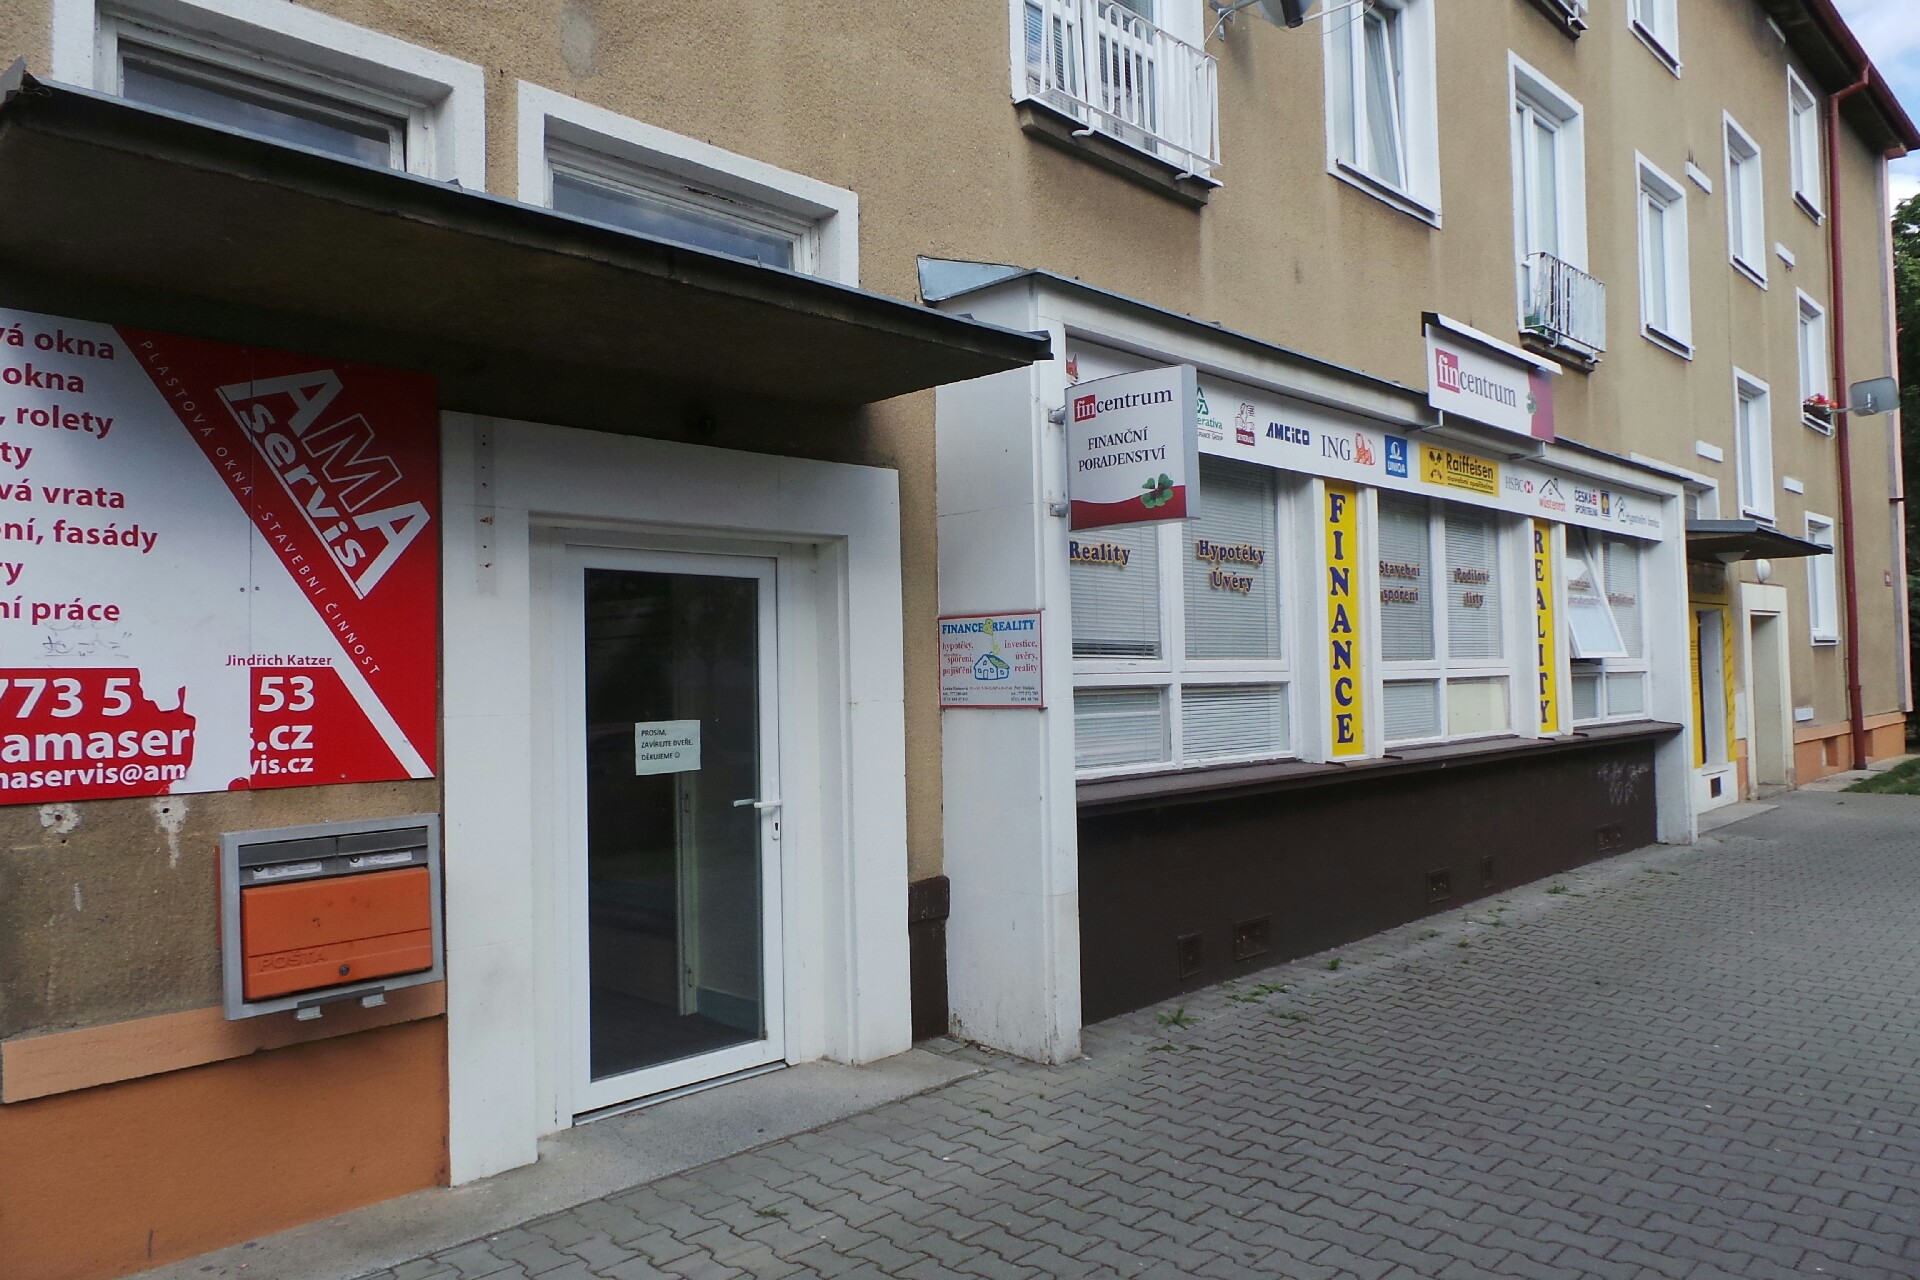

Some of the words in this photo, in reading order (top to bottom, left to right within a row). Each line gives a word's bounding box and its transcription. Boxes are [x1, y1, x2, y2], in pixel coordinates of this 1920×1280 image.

[34, 329, 114, 360] okna
[2, 363, 84, 393] okna
[1437, 352, 1517, 408] fincentrum
[1075, 388, 1173, 420] fincentrum
[17, 405, 113, 440] rolety
[1087, 425, 1149, 451] FINANČNÍ
[1321, 434, 1351, 461] ING
[1078, 445, 1166, 472] PORADENSTVÍ
[1446, 452, 1494, 480] Raiffeisen
[219, 369, 431, 594] AMA
[239, 403, 367, 568] servis
[1505, 475, 1525, 493] HSBC
[42, 487, 125, 509] vrata
[141, 340, 215, 437] PLASTOVÁ
[216, 446, 253, 496] OKNA
[325, 602, 380, 675] ČINNOST
[0, 518, 44, 545] ní,
[53, 519, 158, 554] fasády
[1069, 540, 1131, 566] Reality
[1198, 539, 1266, 565] Hypotéky
[1211, 567, 1254, 592] Úvěry
[1379, 560, 1420, 577] Stavební
[1383, 585, 1419, 602] spoření
[32, 597, 120, 626] práce
[1329, 493, 1354, 744] FINANCE
[942, 622, 983, 635] FINANCE
[993, 619, 1035, 632] REALITY
[1534, 529, 1550, 724] REALITY
[225, 655, 283, 667] Jindřich
[287, 655, 333, 666] Katzer
[1014, 663, 1037, 674] reality
[0, 677, 84, 719] 73
[257, 675, 315, 712] 53
[1, 728, 190, 763] amaser
[641, 752, 674, 761] DĚKUJEME
